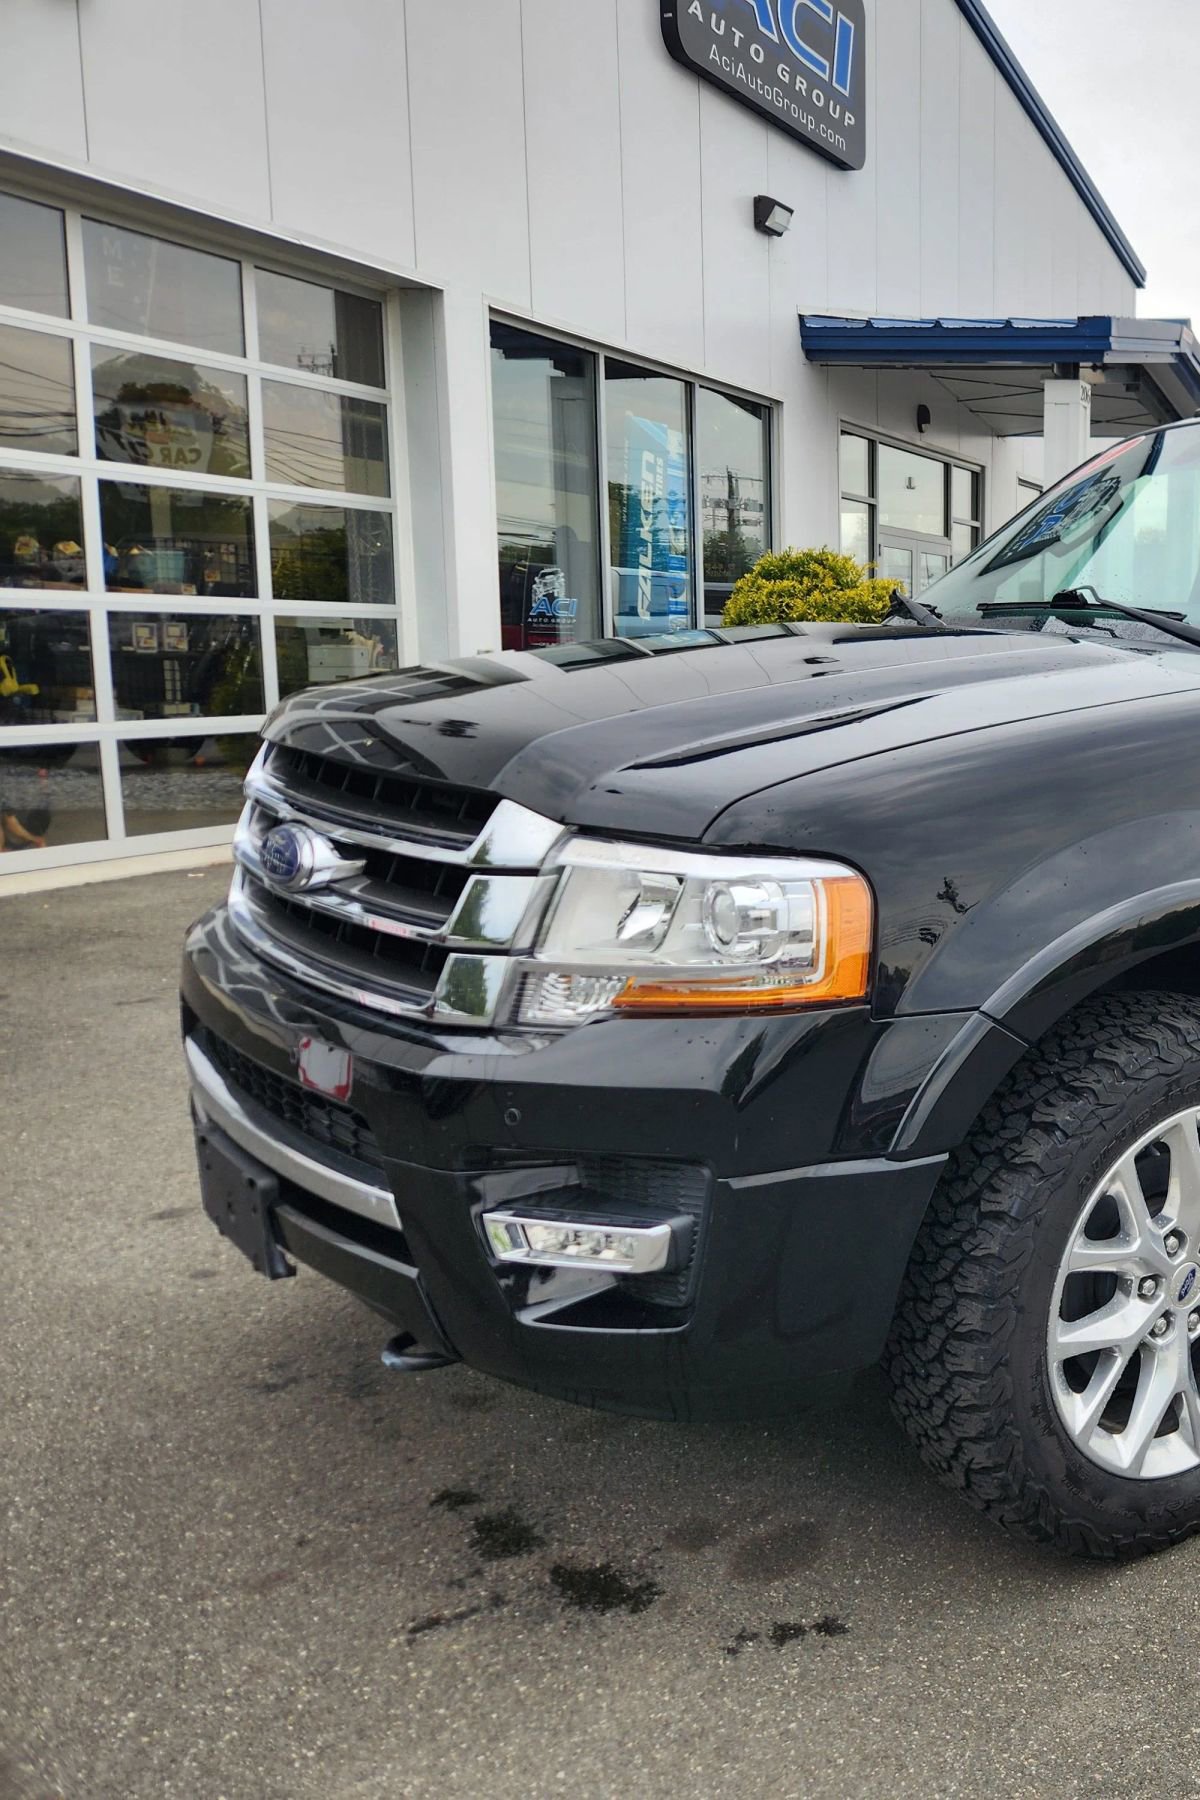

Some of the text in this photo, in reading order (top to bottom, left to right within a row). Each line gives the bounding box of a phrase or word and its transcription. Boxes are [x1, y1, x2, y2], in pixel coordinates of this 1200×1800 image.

[687, 0, 856, 127] AUTO GROUP
[709, 44, 847, 151] AciAutoGroup.com
[655, 456, 664, 496] TIRES
[529, 596, 578, 617] ACI
